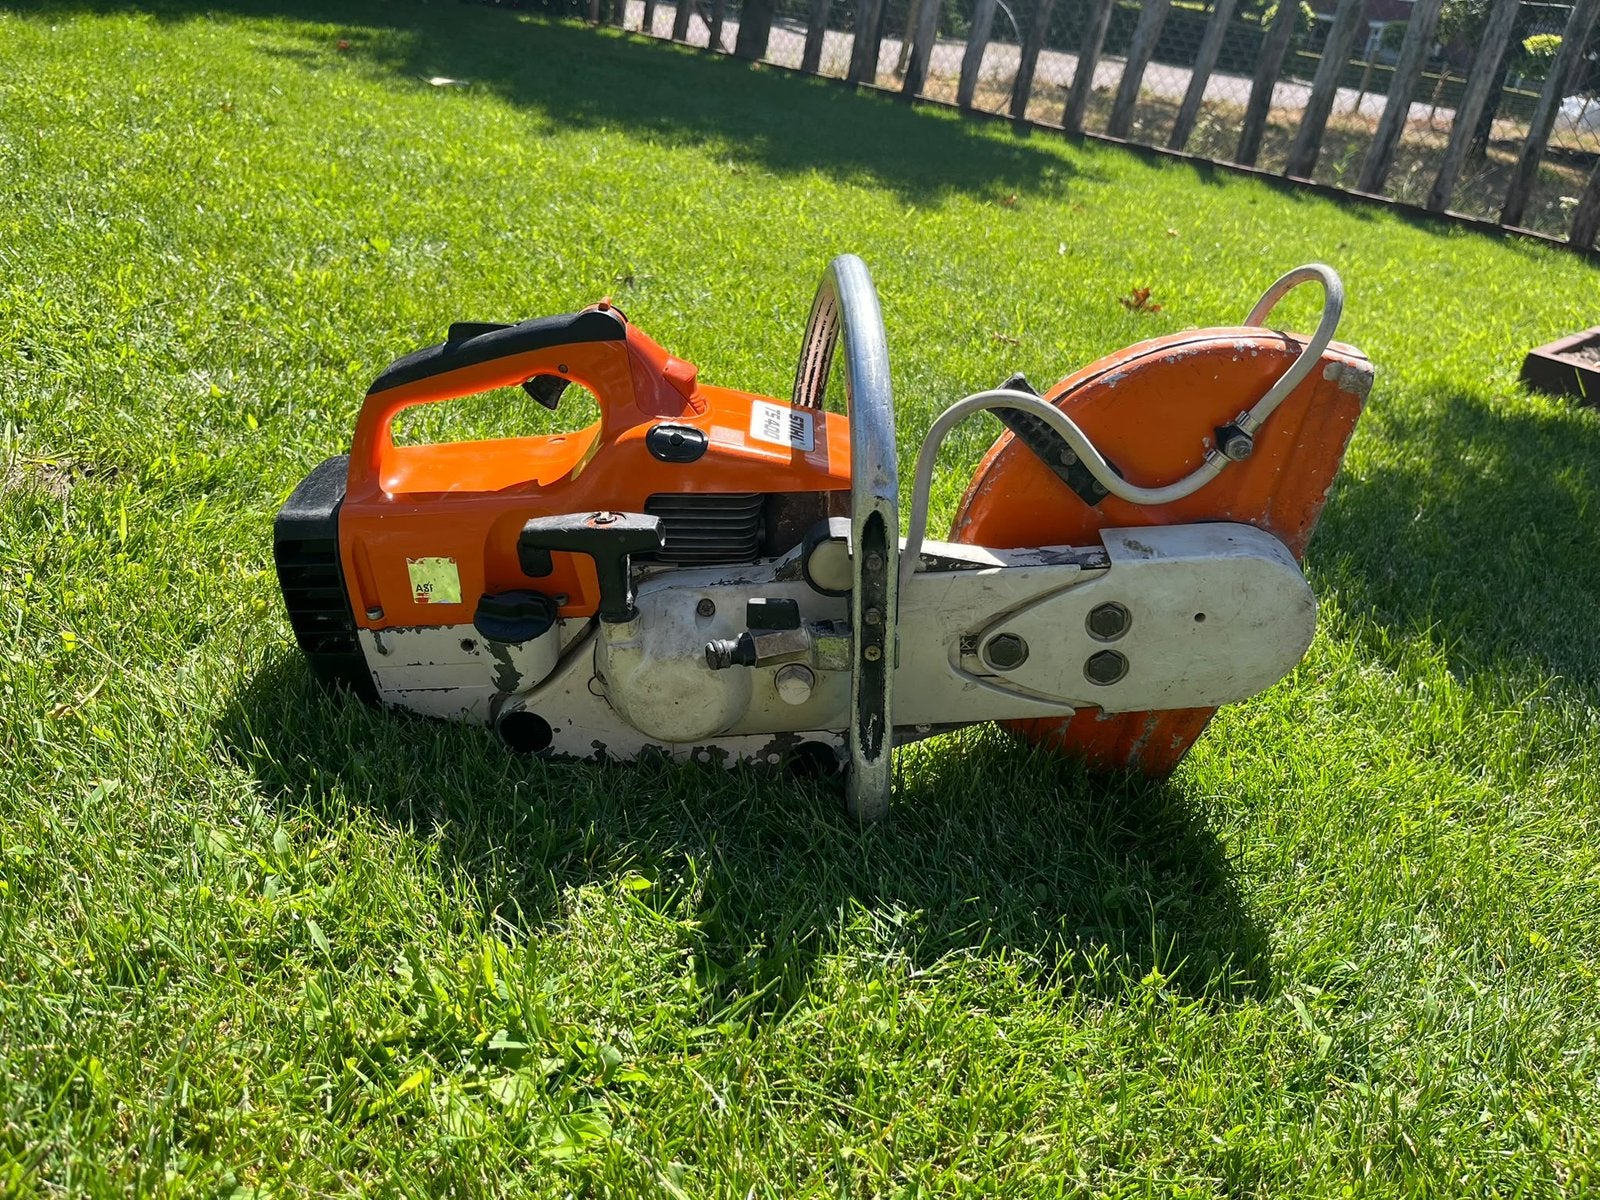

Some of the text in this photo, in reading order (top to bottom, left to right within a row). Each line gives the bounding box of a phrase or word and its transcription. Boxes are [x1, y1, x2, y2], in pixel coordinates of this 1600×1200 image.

[763, 406, 780, 440] TS 400
[789, 413, 804, 441] STIHL
